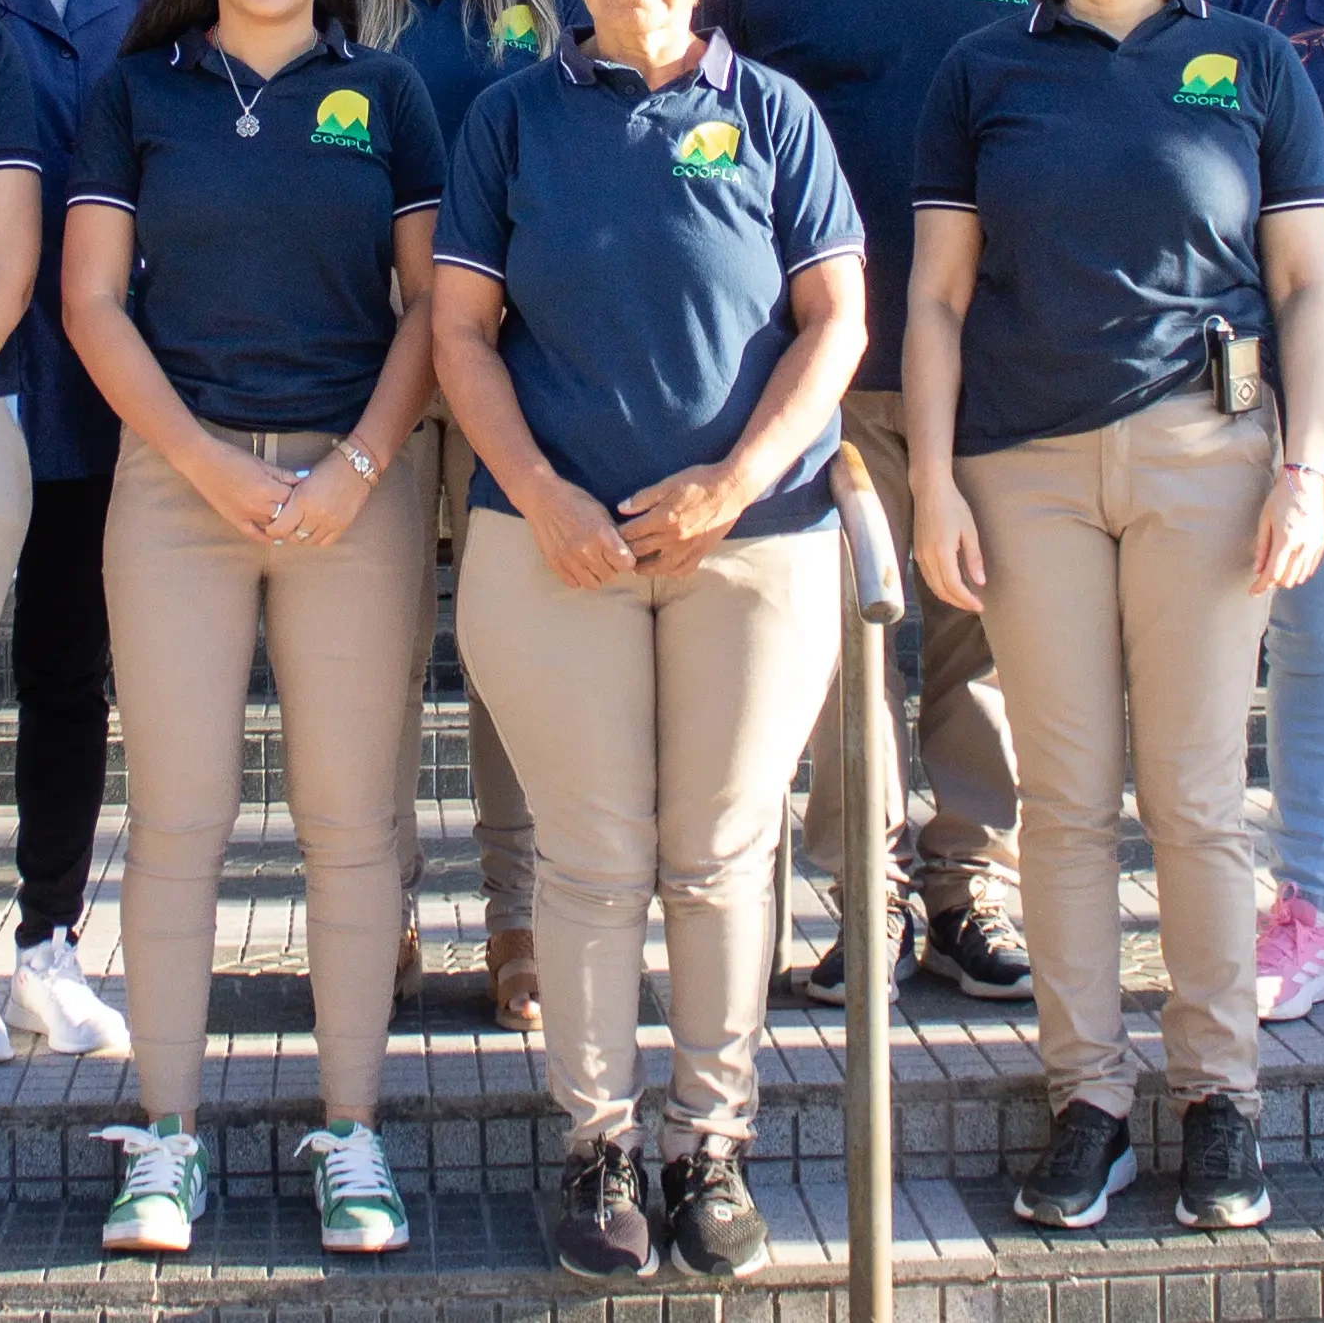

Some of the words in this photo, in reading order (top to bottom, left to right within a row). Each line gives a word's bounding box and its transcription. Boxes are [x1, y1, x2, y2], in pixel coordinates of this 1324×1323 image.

[1173, 93, 1241, 111] COOPLA
[310, 133, 373, 154] COOPLA
[672, 165, 742, 186] COOPLA
